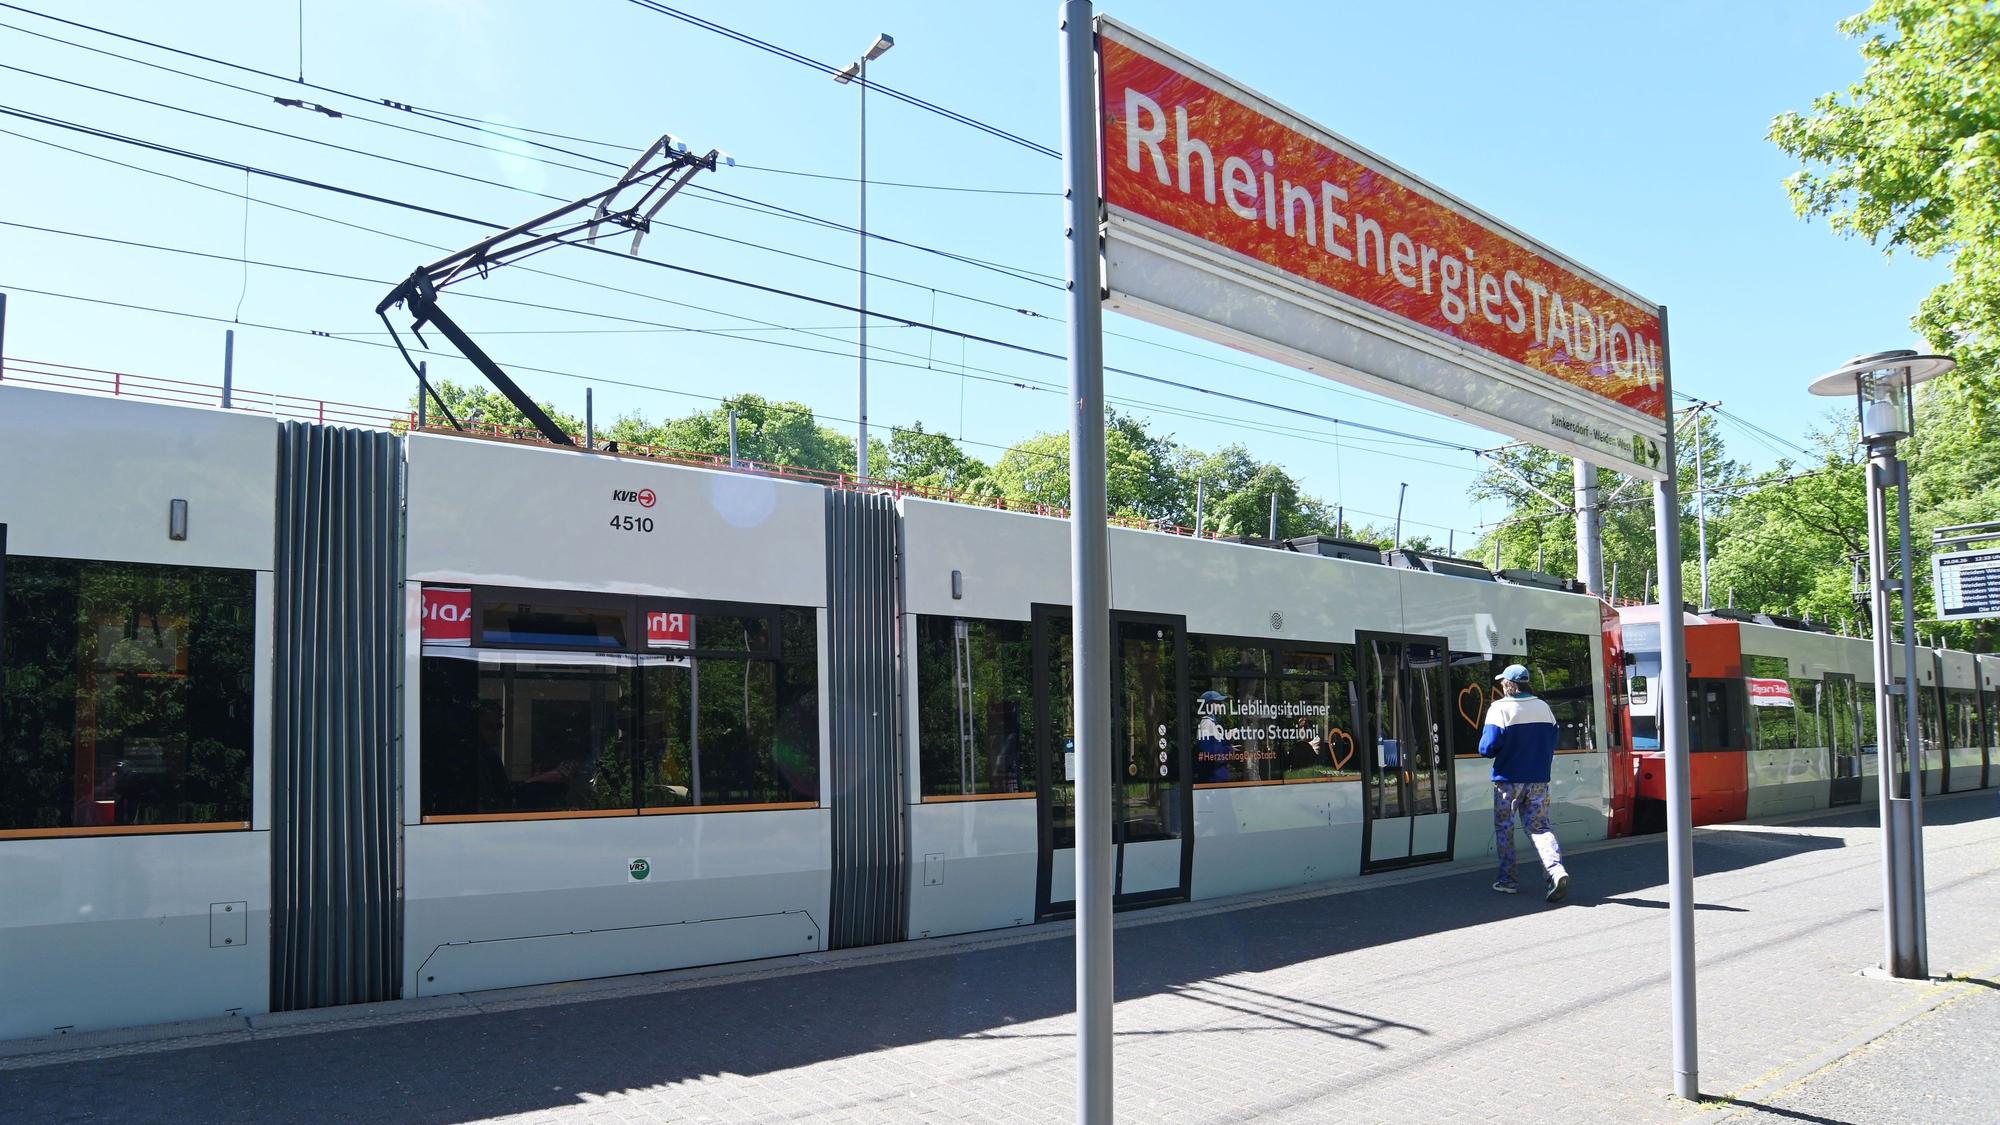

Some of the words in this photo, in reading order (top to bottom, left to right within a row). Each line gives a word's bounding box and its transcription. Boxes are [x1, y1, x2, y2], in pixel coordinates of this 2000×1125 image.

[1124, 87, 1659, 392] RheinEnergieSTADION
[1551, 414, 1589, 437] Junkersdorf
[613, 490, 637, 502] KVB
[610, 515, 654, 532] 4510
[1197, 698, 1226, 715] Zum
[1230, 699, 1330, 719] Lieblingsitaliener
[1198, 723, 1210, 741] in
[1215, 724, 1266, 742] Quattro
[1268, 724, 1319, 740] Stazioni!
[629, 863, 645, 871] VRS
